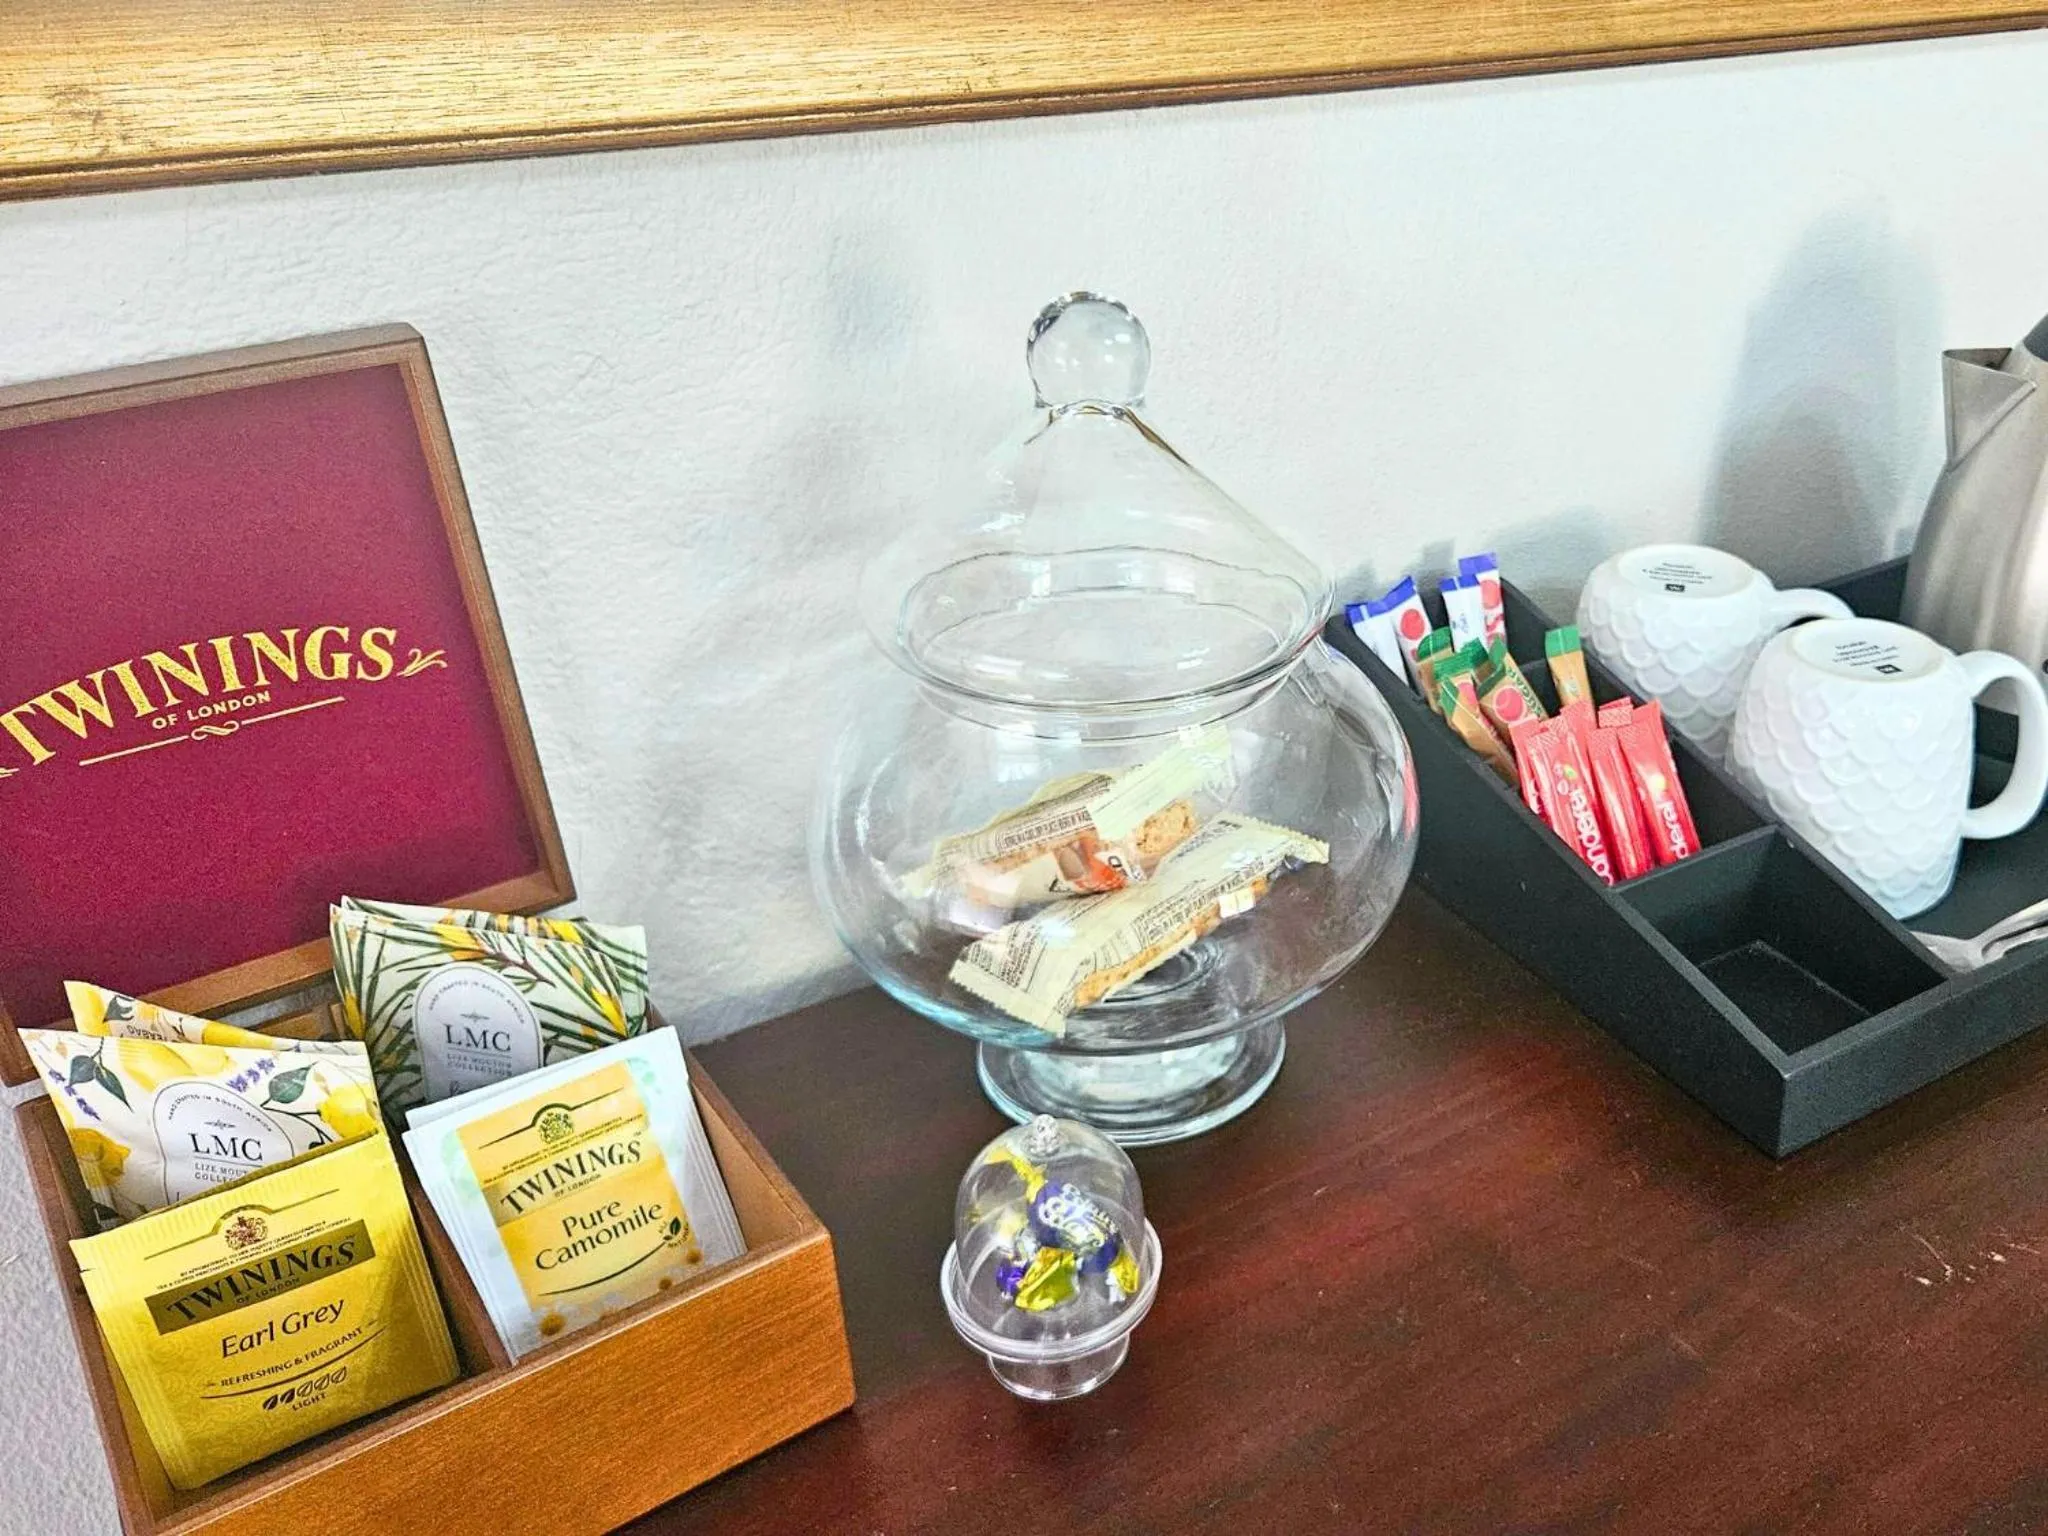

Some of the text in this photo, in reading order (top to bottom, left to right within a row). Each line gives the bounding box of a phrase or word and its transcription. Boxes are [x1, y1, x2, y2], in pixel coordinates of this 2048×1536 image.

[0, 625, 397, 766] TWININGS
[151, 690, 272, 730] OF LONDON
[1658, 800, 1690, 859] derel
[443, 1022, 512, 1053] LMC
[187, 1132, 263, 1162] LMC
[194, 1162, 249, 1176] LIZE MOUT
[500, 1139, 642, 1215] TWININGS
[554, 1174, 602, 1198] OF LONDON
[535, 1203, 664, 1272] Camomile
[561, 1199, 621, 1239] Pure
[167, 1241, 355, 1321] TWININGS
[235, 1278, 300, 1304] OF LONDON
[220, 1298, 346, 1359] Earl Grey
[220, 1327, 363, 1387] REFRESHING & FRAGRANT
[292, 1392, 328, 1412] LIGHT
